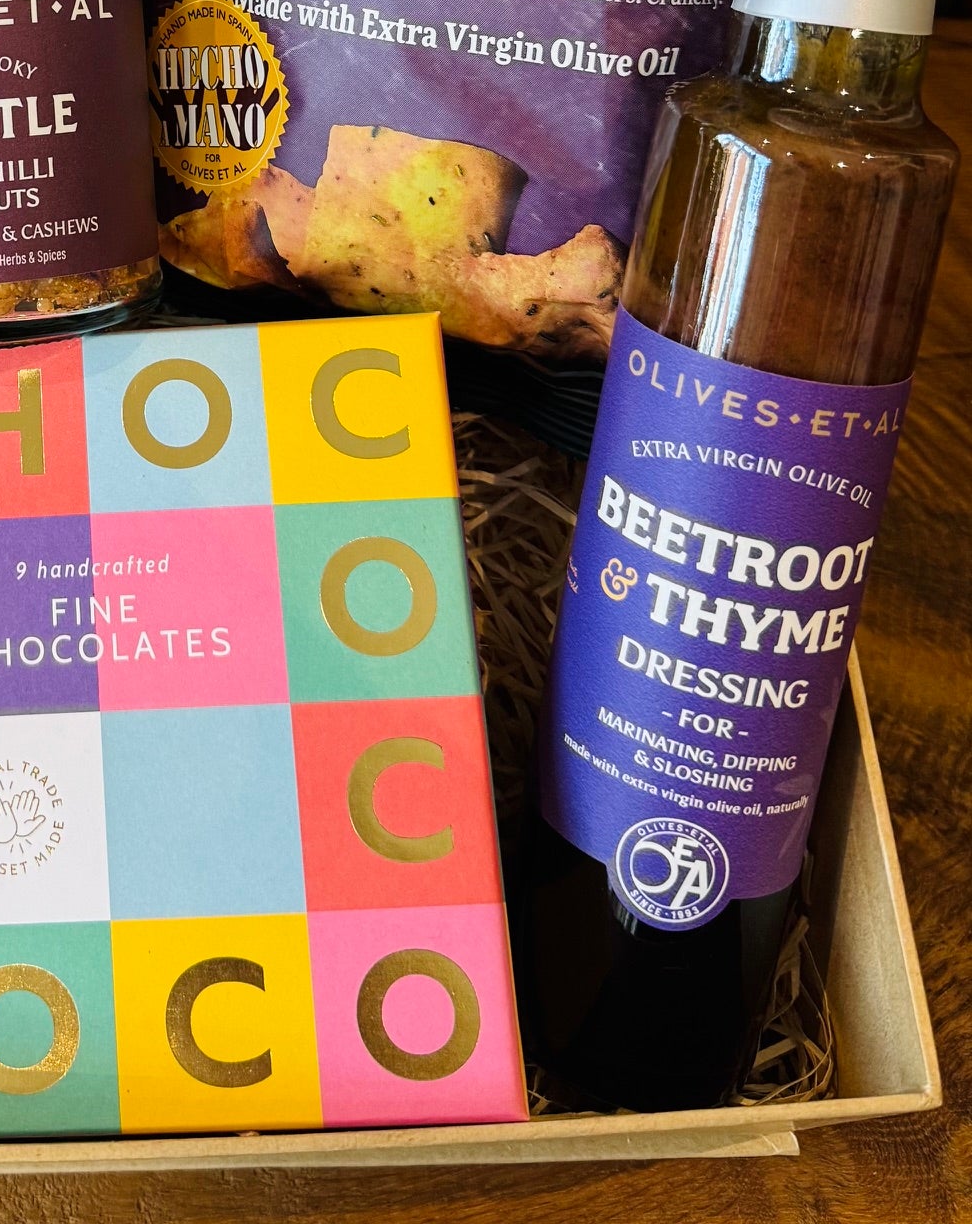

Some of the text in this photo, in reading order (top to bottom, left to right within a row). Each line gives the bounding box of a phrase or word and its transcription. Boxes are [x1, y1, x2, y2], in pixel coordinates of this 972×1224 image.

[160, 7, 252, 44] HAND MADE SPAIN
[297, 0, 355, 35] with
[359, 8, 438, 49] Extra
[444, 21, 544, 66] Virgin
[550, 38, 633, 77] Olive
[637, 47, 679, 76] Oil
[158, 45, 265, 90] HECHO
[173, 103, 266, 148] MANO
[181, 160, 246, 180] OLIVES ET AL
[205, 154, 220, 162] FOR
[2, 226, 18, 242] &
[21, 216, 99, 240] CASHEWS
[0, 251, 26, 266] Herbs
[37, 249, 66, 266] Spices
[631, 440, 874, 509] EXTRA VIRGIN OLIVE OIL
[596, 475, 874, 591] BEETROOT
[16, 553, 169, 580] 9 handcrafted
[51, 594, 137, 626] FINE
[600, 557, 638, 602] &
[646, 572, 849, 655] THYME
[617, 635, 809, 708] DRESSING
[597, 707, 797, 772] MARINATING, DIPPING
[22, 761, 63, 808] TRADE
[563, 733, 809, 817] made with extra virgin olive oil, naturally
[652, 758, 754, 792] SLOSHING
[34, 821, 64, 867] MADE
